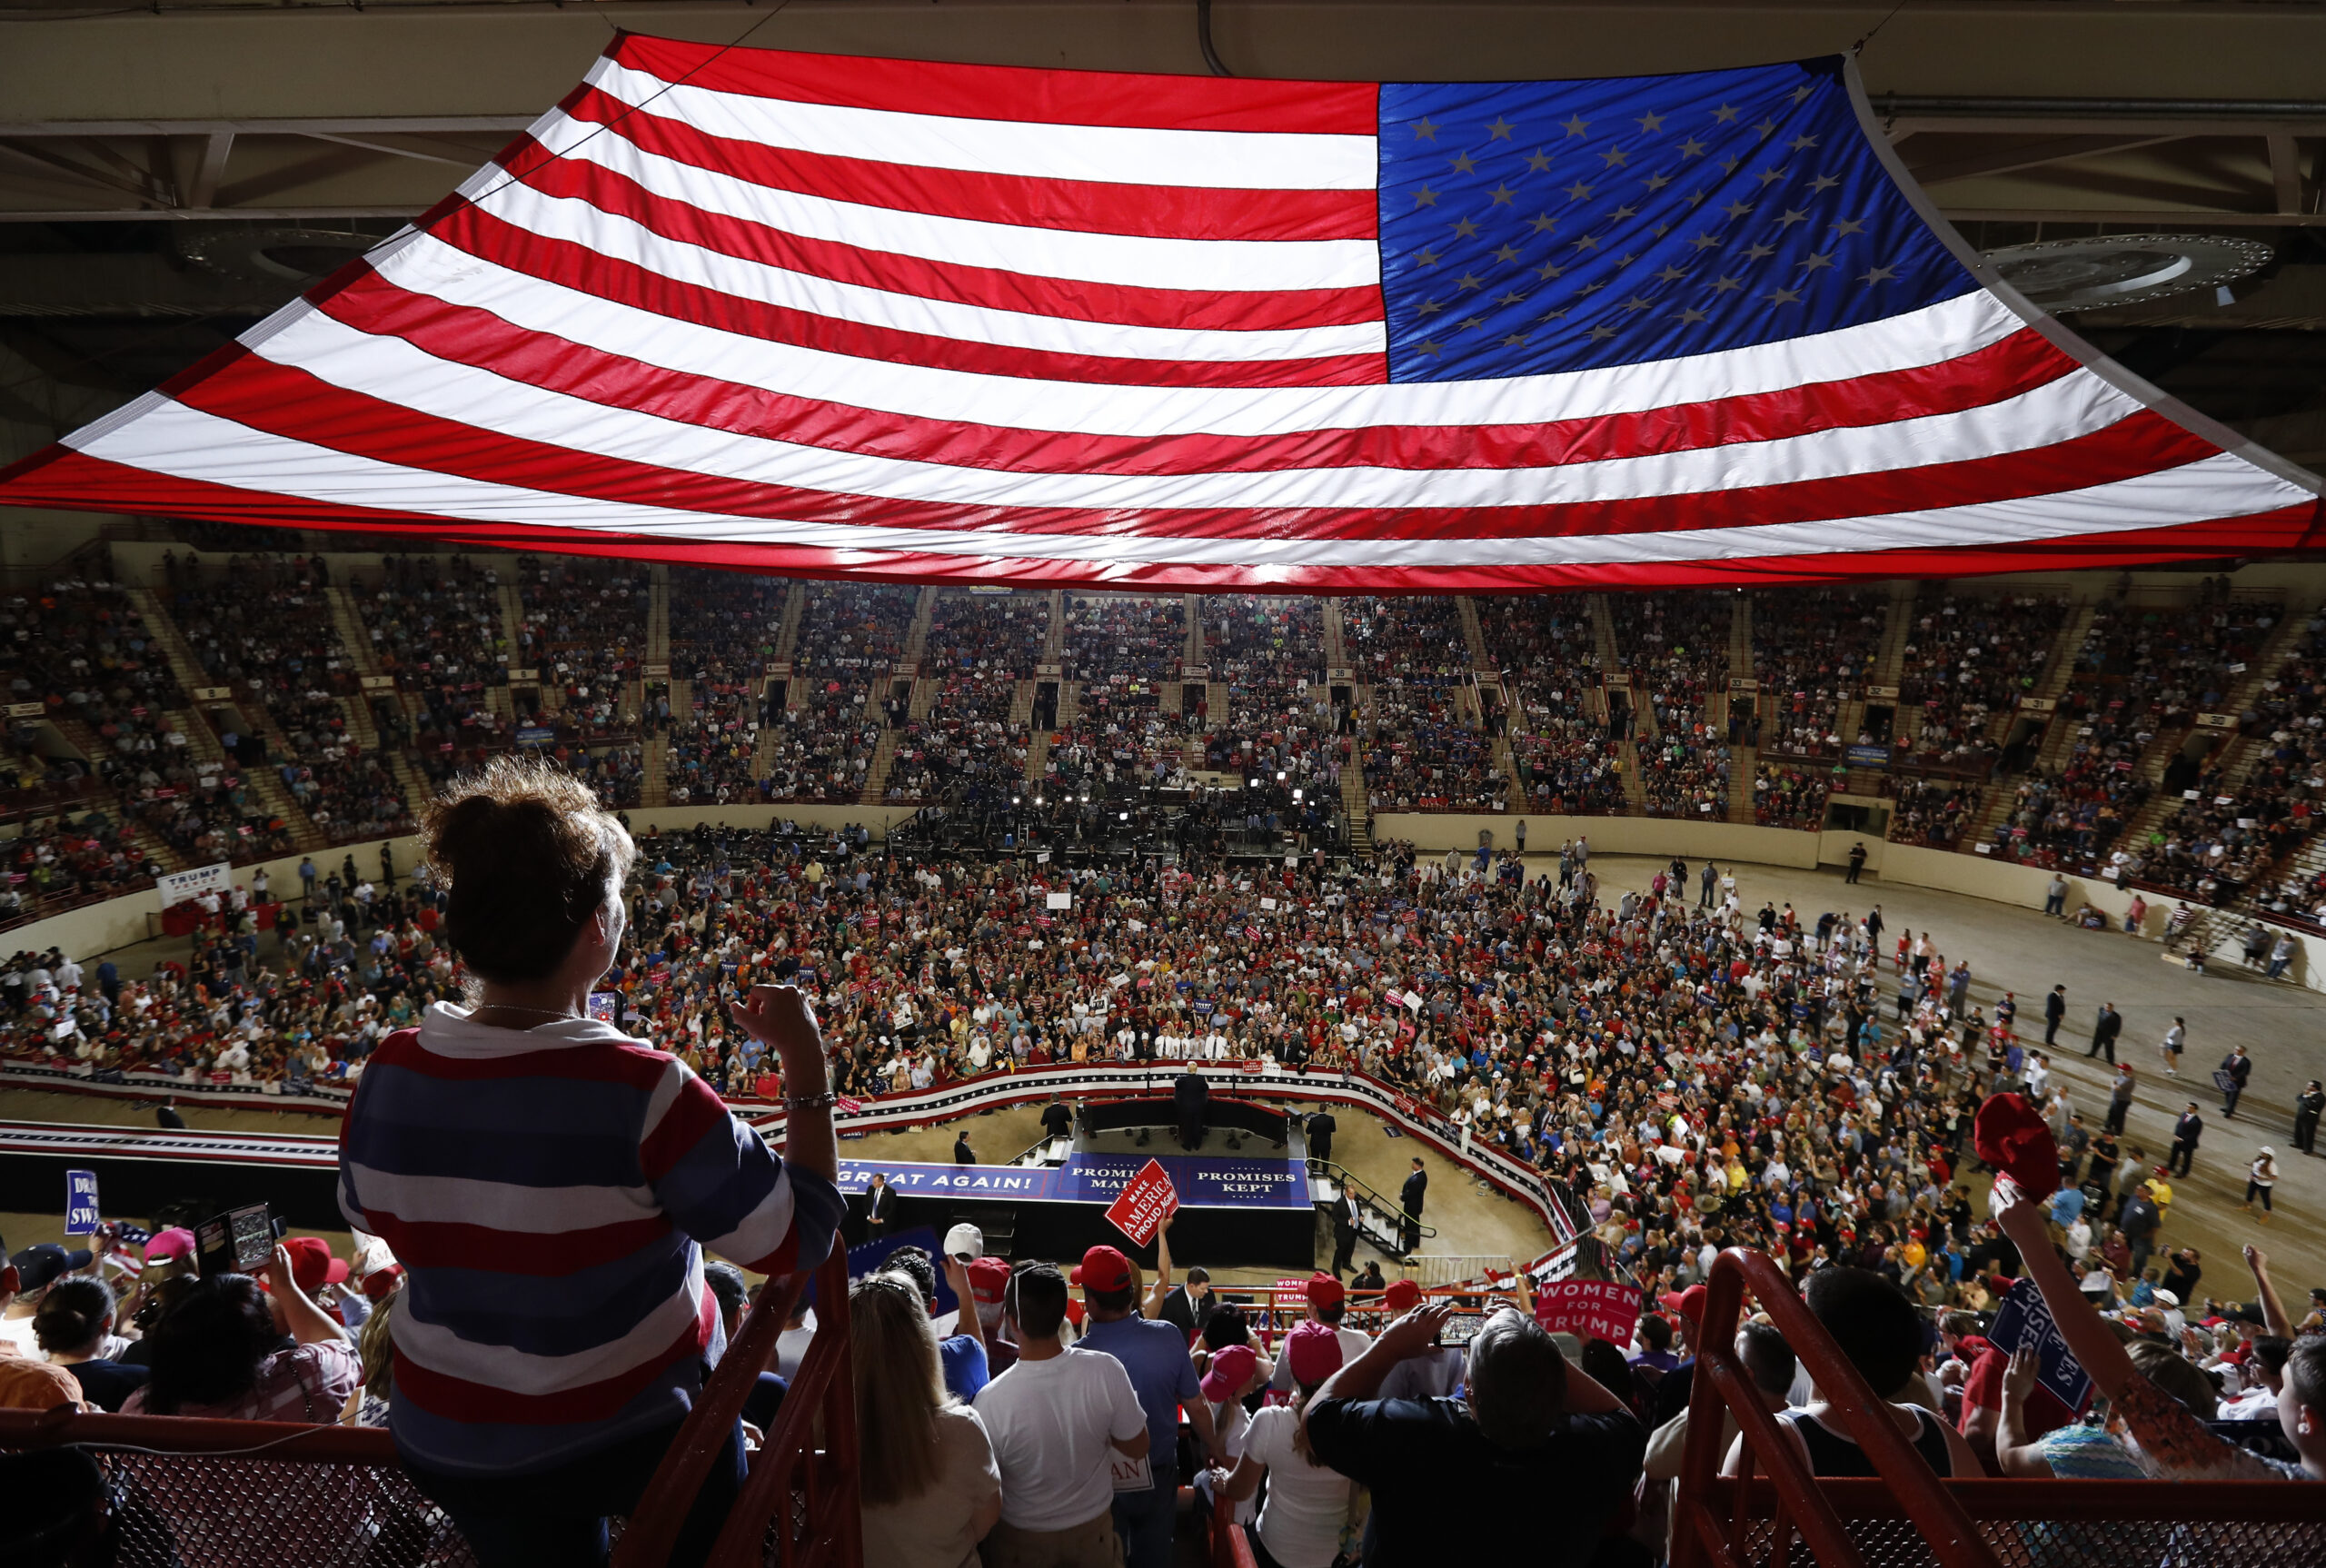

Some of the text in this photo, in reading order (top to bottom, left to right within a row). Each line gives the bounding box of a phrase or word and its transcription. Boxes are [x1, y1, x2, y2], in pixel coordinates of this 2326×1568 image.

[1336, 669, 1345, 677] 36
[2033, 700, 2044, 708] 31
[2210, 716, 2225, 725] 30
[168, 868, 220, 885] TRUMP
[841, 1096, 861, 1106] WOMEN
[840, 1103, 858, 1113] TRUMP
[932, 1175, 1032, 1189] AGAIN!
[1198, 1172, 1297, 1182] PROMISES
[1128, 1179, 1149, 1204] MAKE
[1222, 1184, 1273, 1193] KEPT
[1124, 1176, 1171, 1235] AMERICA
[1134, 1189, 1176, 1240] PROUD AGAIN
[1540, 1284, 1639, 1307] WOMEN
[1566, 1300, 1601, 1312] FOR
[1539, 1315, 1626, 1338] TRUMP
